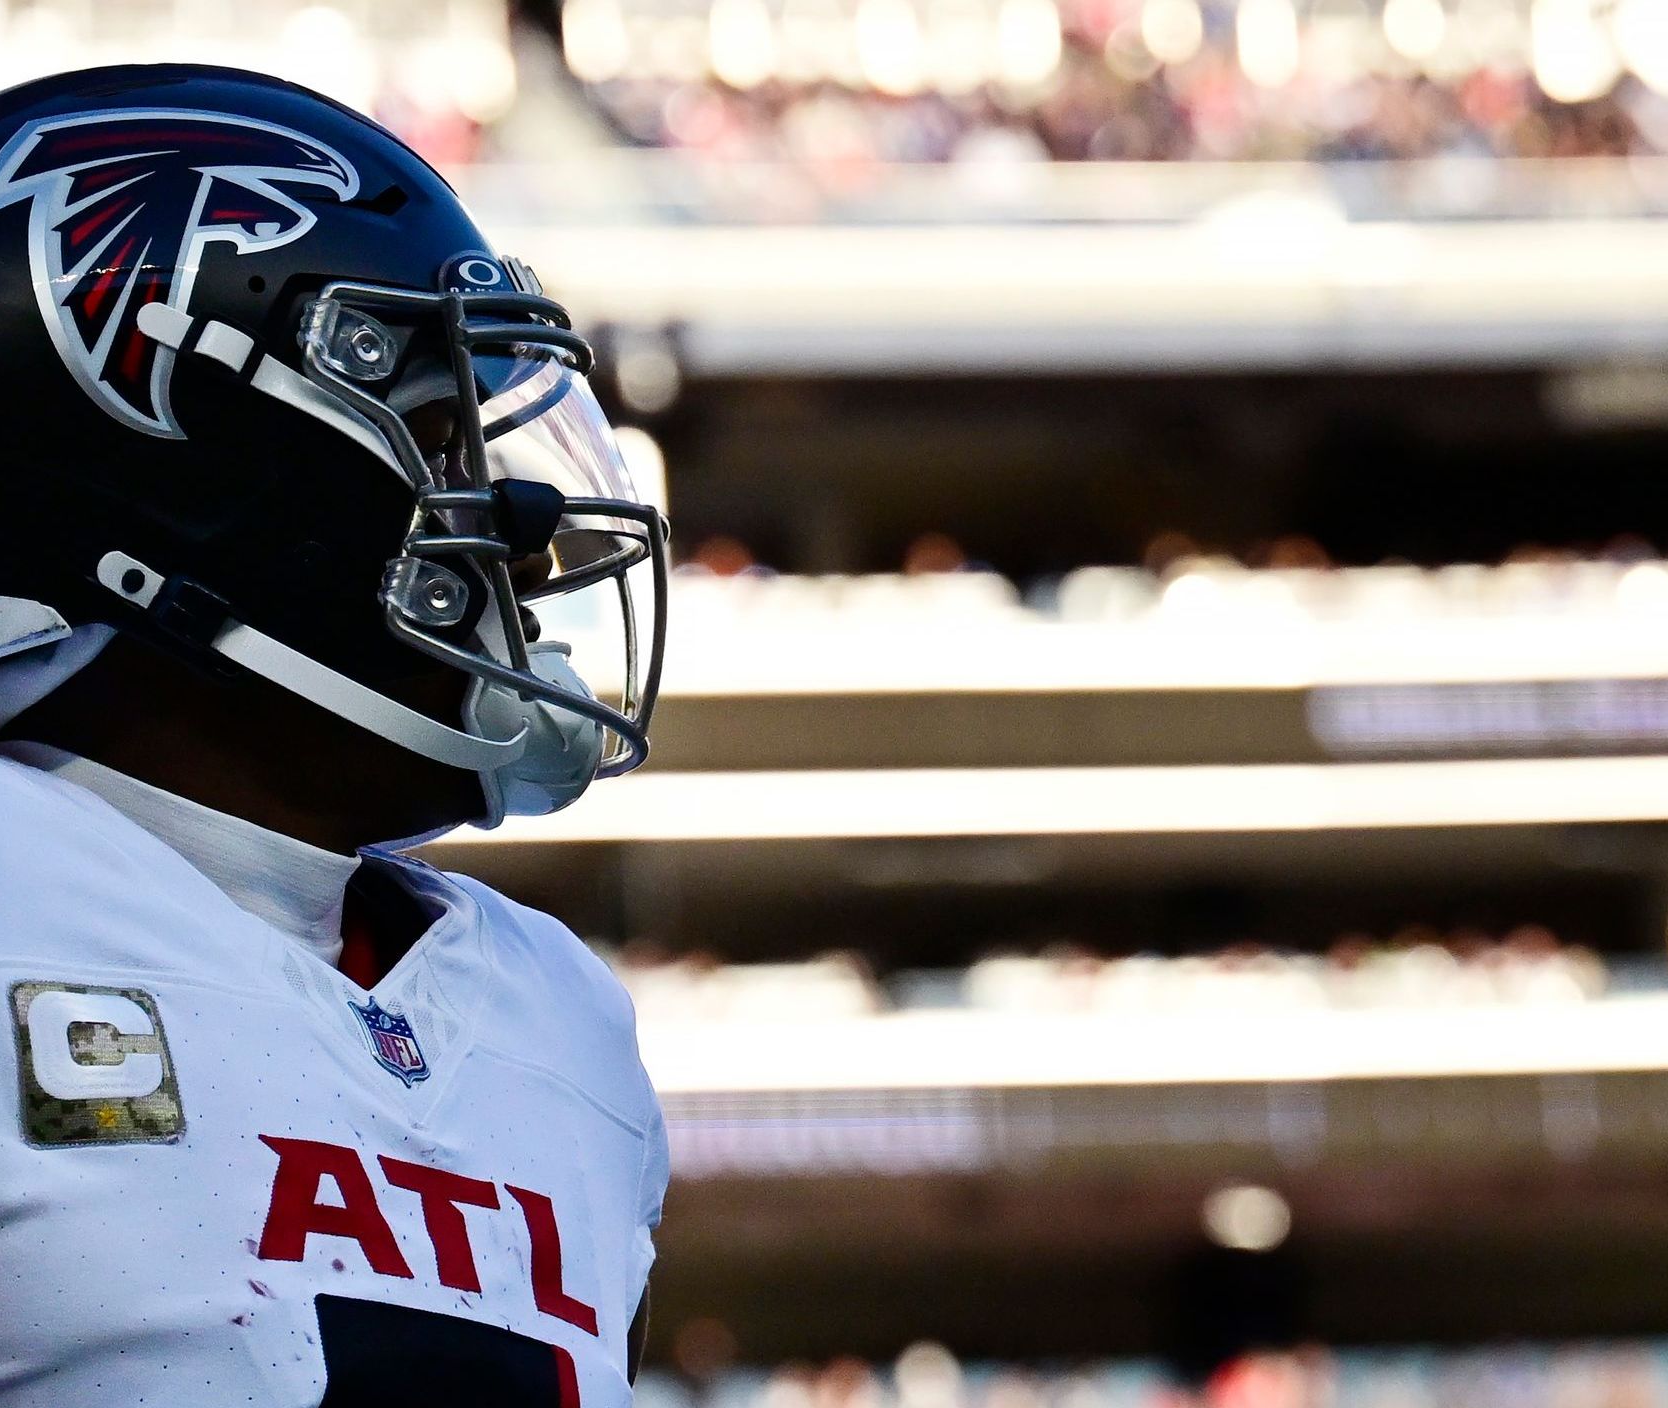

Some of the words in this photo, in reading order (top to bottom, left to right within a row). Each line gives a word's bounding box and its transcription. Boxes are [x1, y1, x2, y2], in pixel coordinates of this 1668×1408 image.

[28, 991, 165, 1101] C
[372, 1029, 423, 1070] NFL
[258, 1134, 599, 1337] ATL
